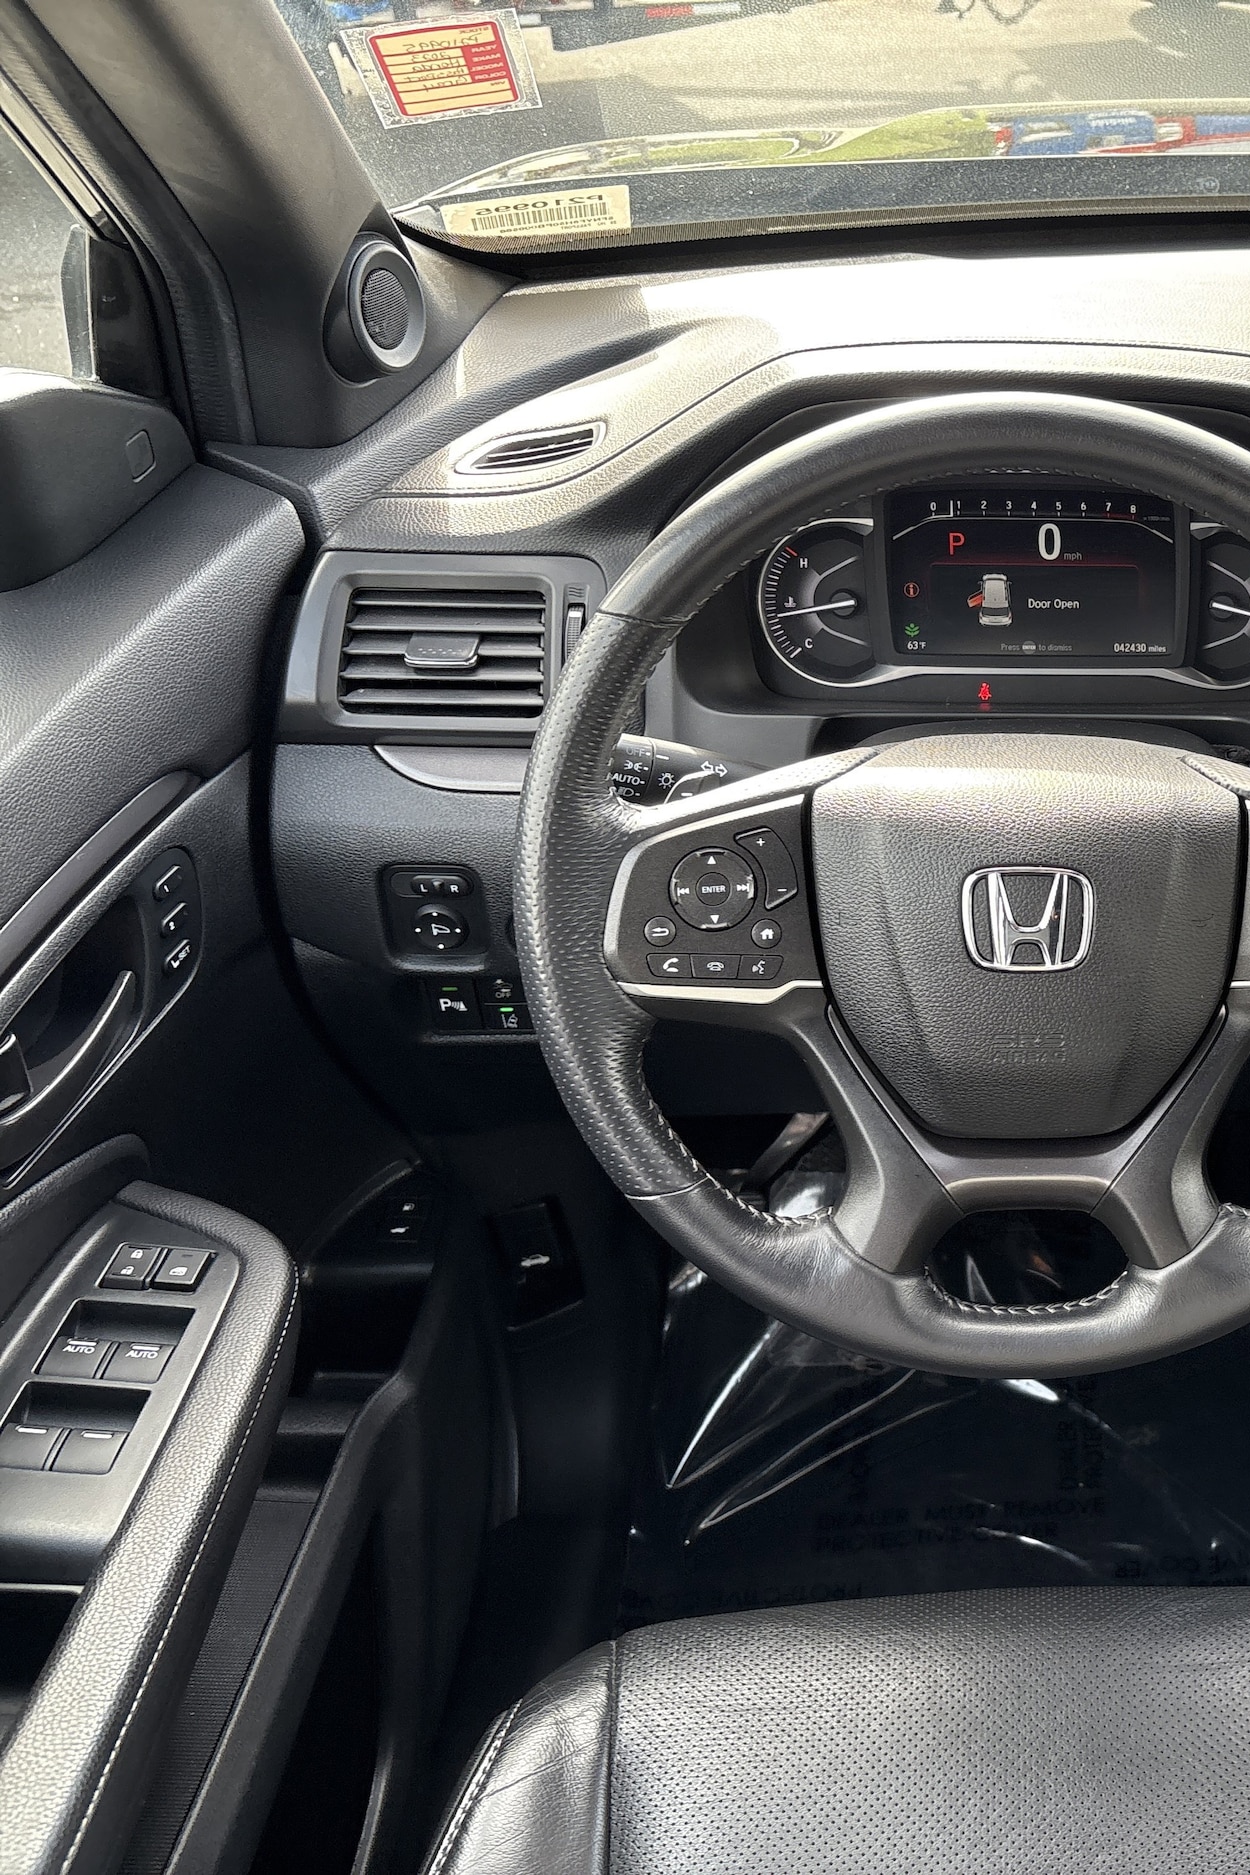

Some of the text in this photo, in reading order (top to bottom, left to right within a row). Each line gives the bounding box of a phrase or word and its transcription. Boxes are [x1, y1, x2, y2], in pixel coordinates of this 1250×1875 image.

[930, 501, 1137, 514] 0 1 2 3 4 5 6 7 8
[949, 532, 966, 555] P
[1038, 523, 1082, 562] 0 mph
[800, 558, 808, 569] H
[1028, 598, 1080, 611] Door Open
[804, 638, 813, 649] C
[1000, 643, 1020, 651] Press
[1047, 643, 1073, 651] dismiss
[1114, 643, 1167, 653] 042430 miles
[626, 747, 645, 757] OFF
[611, 773, 640, 785] AUTO
[420, 884, 428, 892] L
[450, 884, 459, 893] R
[701, 885, 726, 893] ENTER
[62, 1344, 95, 1354] AUTO
[125, 1350, 158, 1359] AUTO
